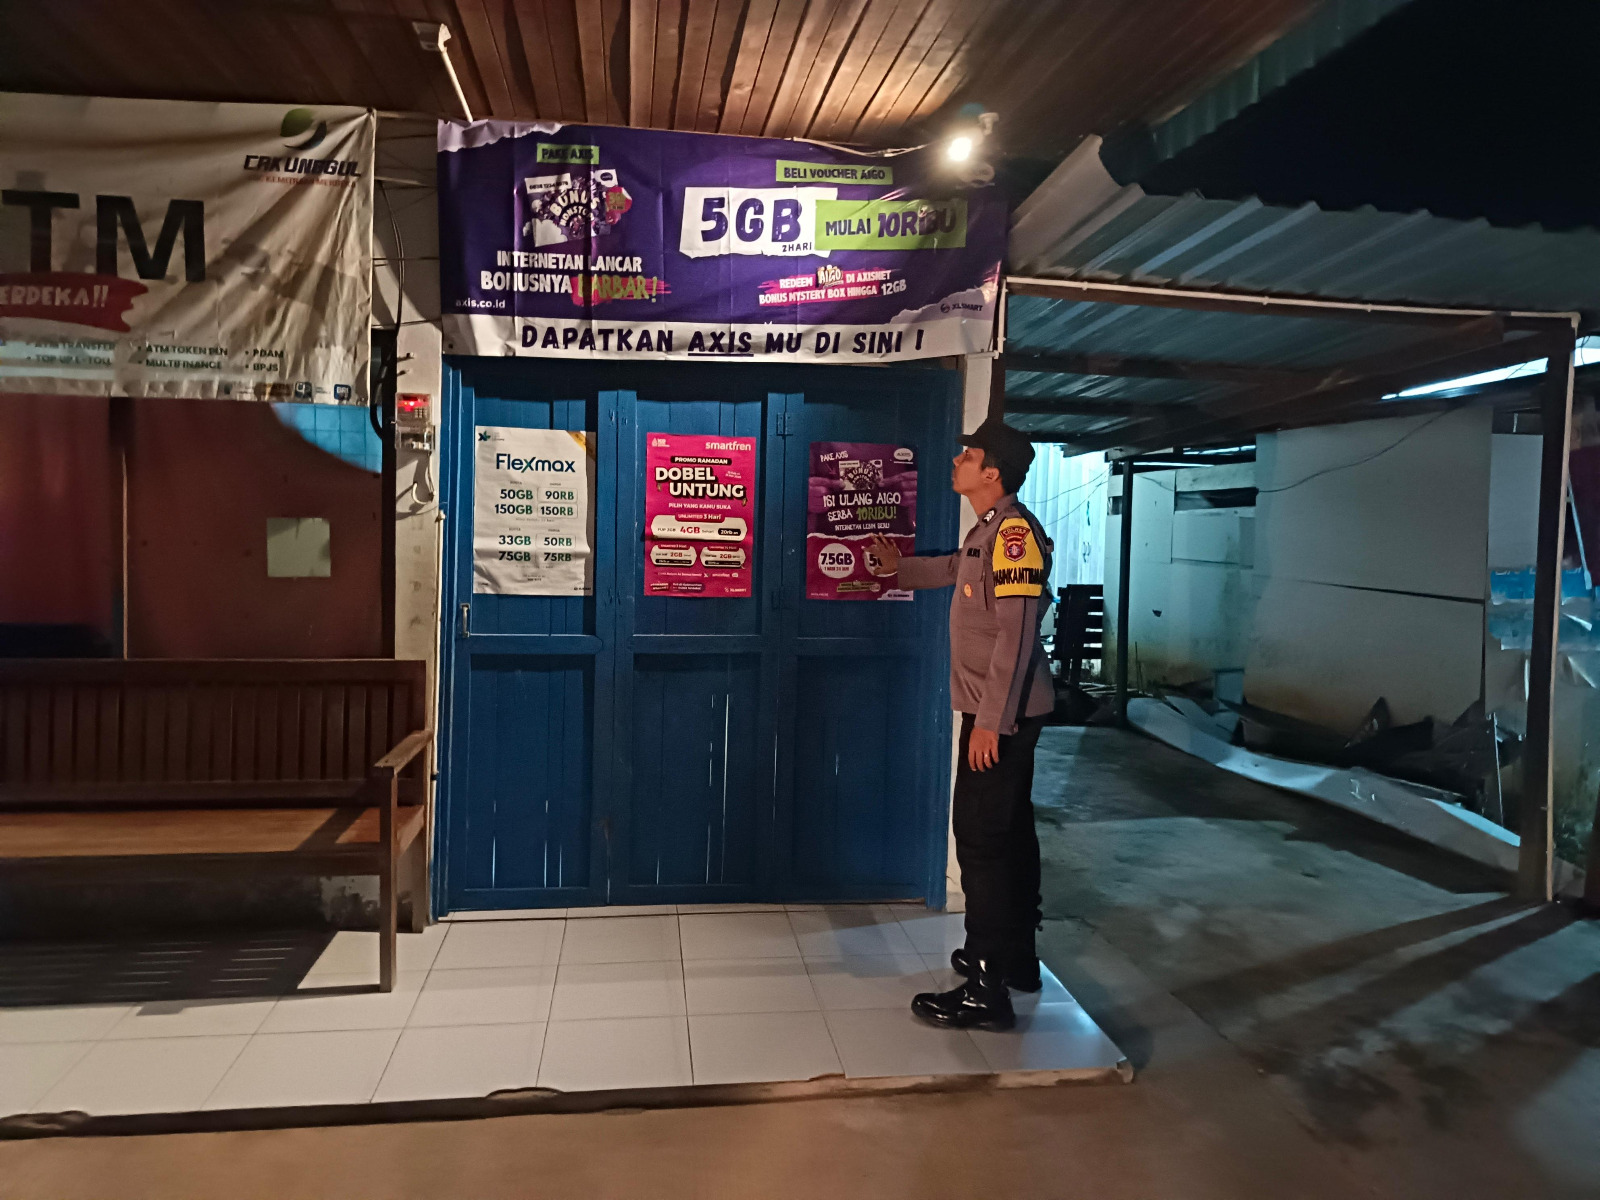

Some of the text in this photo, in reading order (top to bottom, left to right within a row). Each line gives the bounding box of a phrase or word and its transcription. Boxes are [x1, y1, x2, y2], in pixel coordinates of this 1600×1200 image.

[783, 167, 885, 180] BELI VOUCHER AIGO
[700, 196, 802, 243] 5GB
[825, 217, 870, 236] MULAI
[781, 241, 812, 253] 2HARI
[496, 250, 642, 273] INTERNETAN LANCAR
[480, 271, 573, 294] BONUSNYA
[779, 277, 813, 289] REDEEM
[818, 268, 843, 284] AIGO
[845, 273, 856, 284] DI
[857, 270, 891, 283] AXISNET
[758, 293, 787, 305] BONUS
[789, 290, 826, 302] MYSTERY
[827, 288, 846, 299] BOX
[847, 286, 877, 297] HINGGA
[881, 279, 907, 296] 12GB
[455, 298, 506, 309] axis.co.id
[521, 323, 673, 351] DAPATKAN
[687, 330, 752, 353] AXIS
[765, 332, 802, 354] MU
[815, 331, 840, 354] DI
[852, 330, 902, 353] SINI
[705, 440, 751, 451] smartfren
[496, 453, 576, 474] Flexmax
[698, 457, 729, 465] RAMADAN
[655, 466, 716, 481] DOBEL
[500, 489, 575, 501] 50GB 90RB
[669, 482, 744, 498] UNTUNG
[823, 491, 902, 507] ISI ULANG AIGO
[494, 504, 574, 516] 150GB 150RB
[827, 508, 853, 521] SERBA
[679, 526, 700, 534] 4GB
[498, 535, 573, 547] 33GB 50RB
[498, 550, 572, 562] 75GB 75RB
[820, 552, 854, 566] 7.5GB
